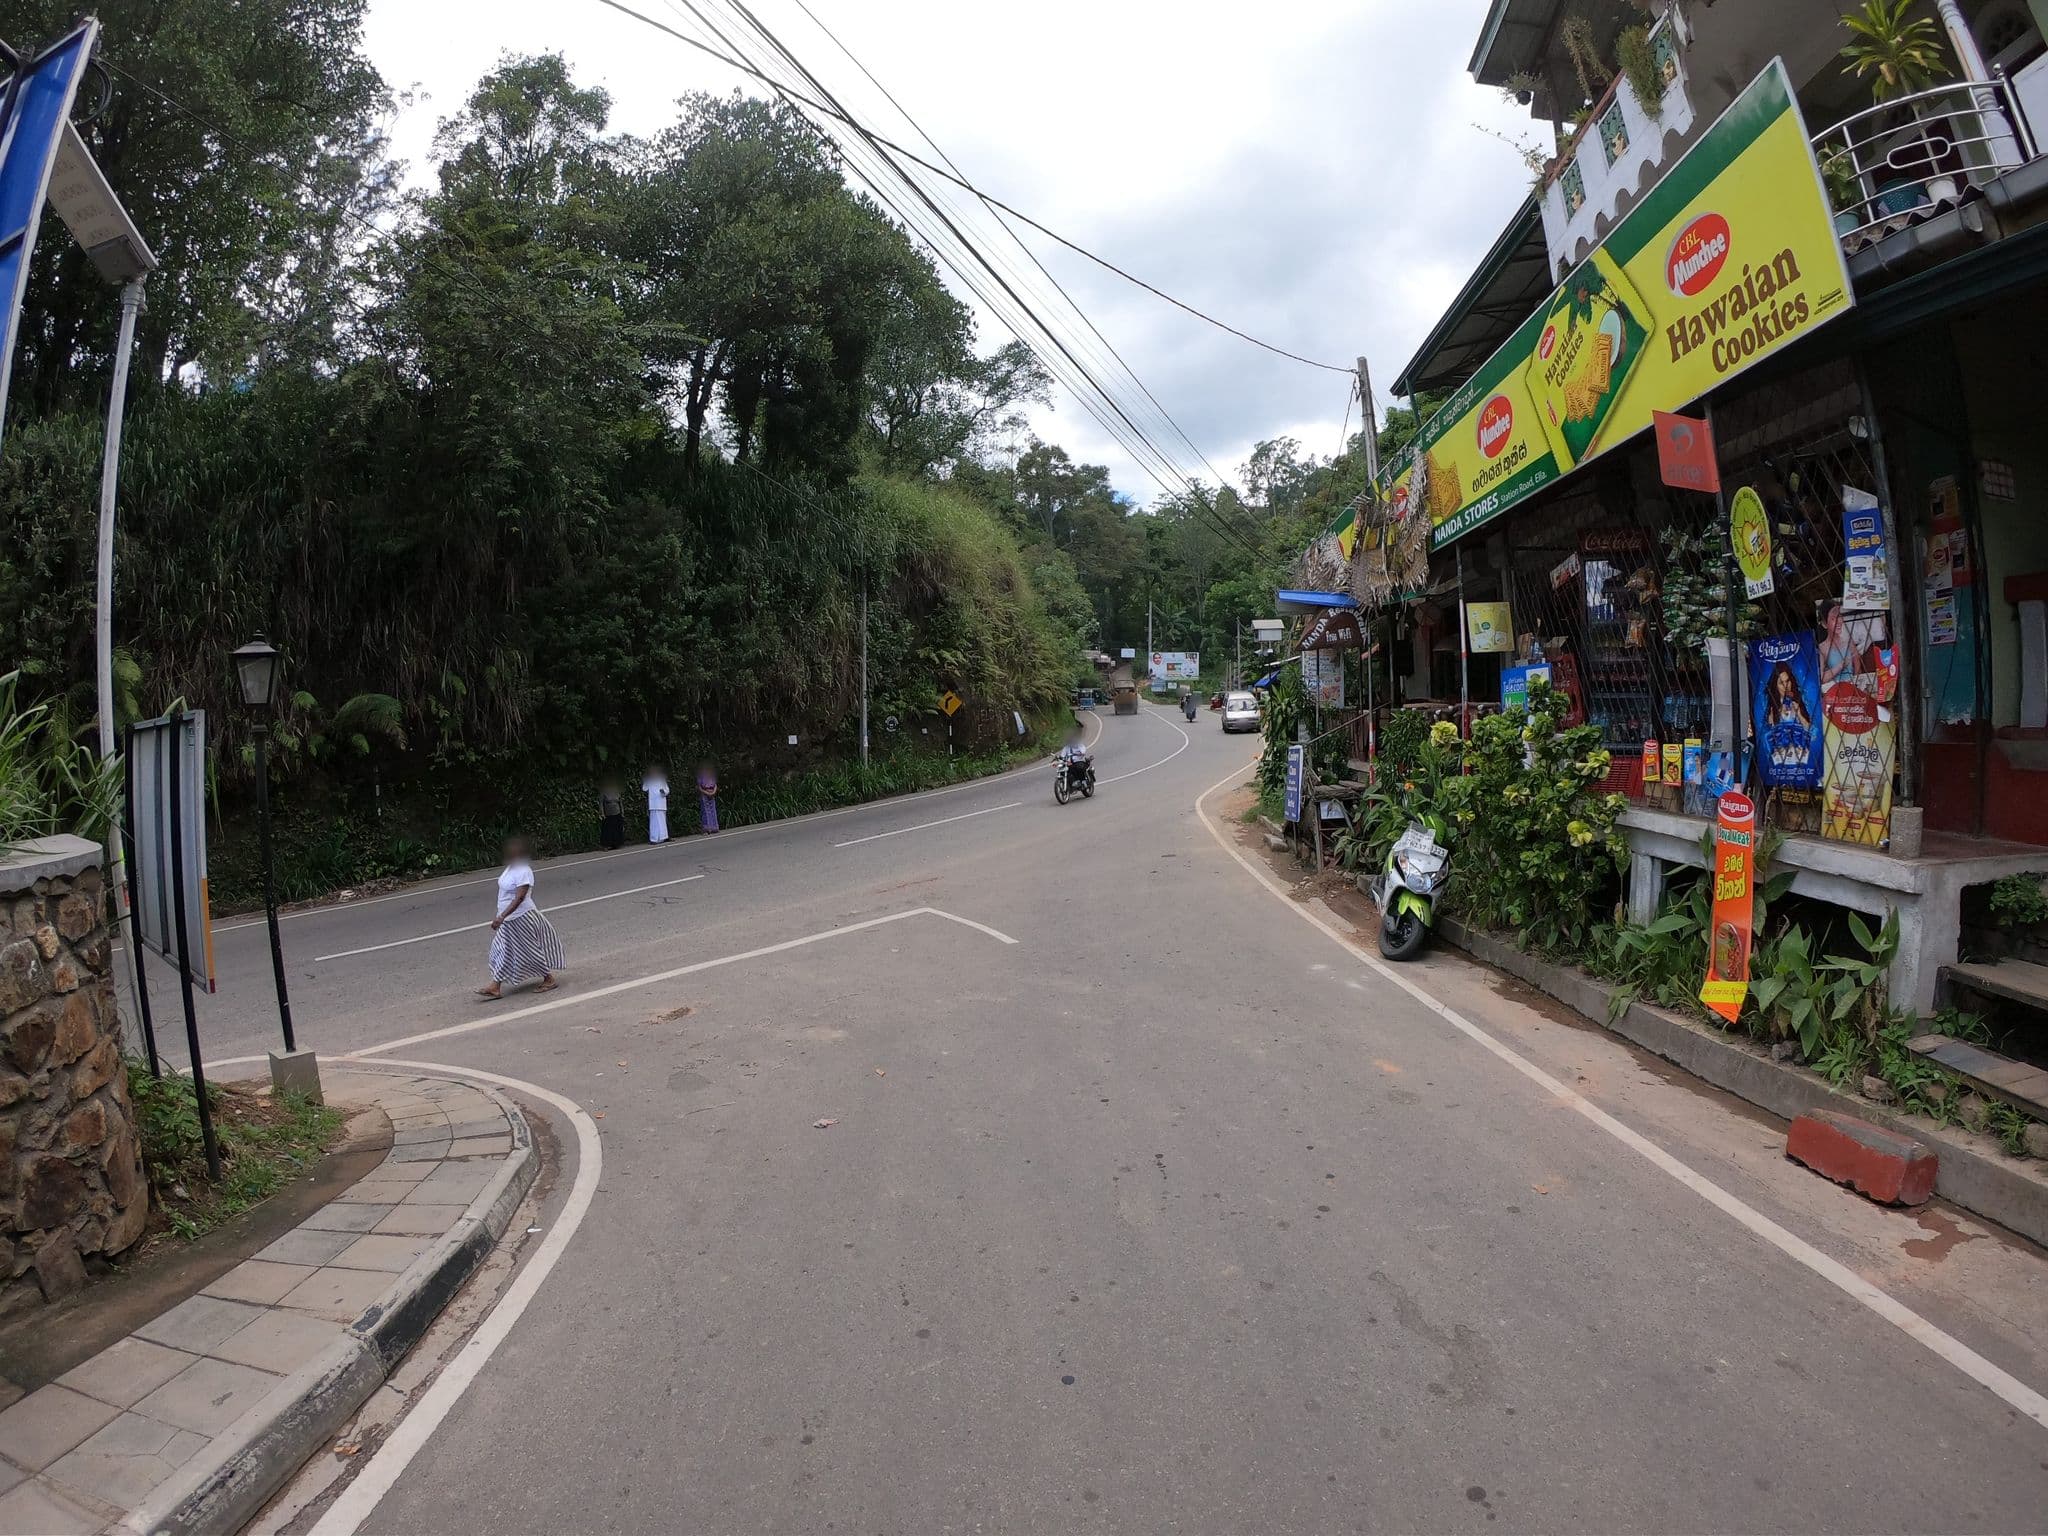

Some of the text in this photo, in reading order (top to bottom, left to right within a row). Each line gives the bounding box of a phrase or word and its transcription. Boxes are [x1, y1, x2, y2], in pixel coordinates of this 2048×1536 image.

[1674, 233, 1727, 291] Munchee
[1678, 230, 1702, 257] CBL
[1666, 248, 1801, 363] Hawaian
[1712, 292, 1809, 372] Cookies
[1556, 331, 1584, 388] Cookies
[1480, 412, 1510, 452] Munchee
[1434, 515, 1463, 544] NANDA
[1465, 491, 1499, 526] STORES
[1501, 487, 1519, 505] Station
[1302, 618, 1328, 649] NANDA
[1759, 640, 1800, 659] Ritzbury
[1503, 682, 1525, 692] Telecom
[1720, 798, 1749, 813] Raigam
